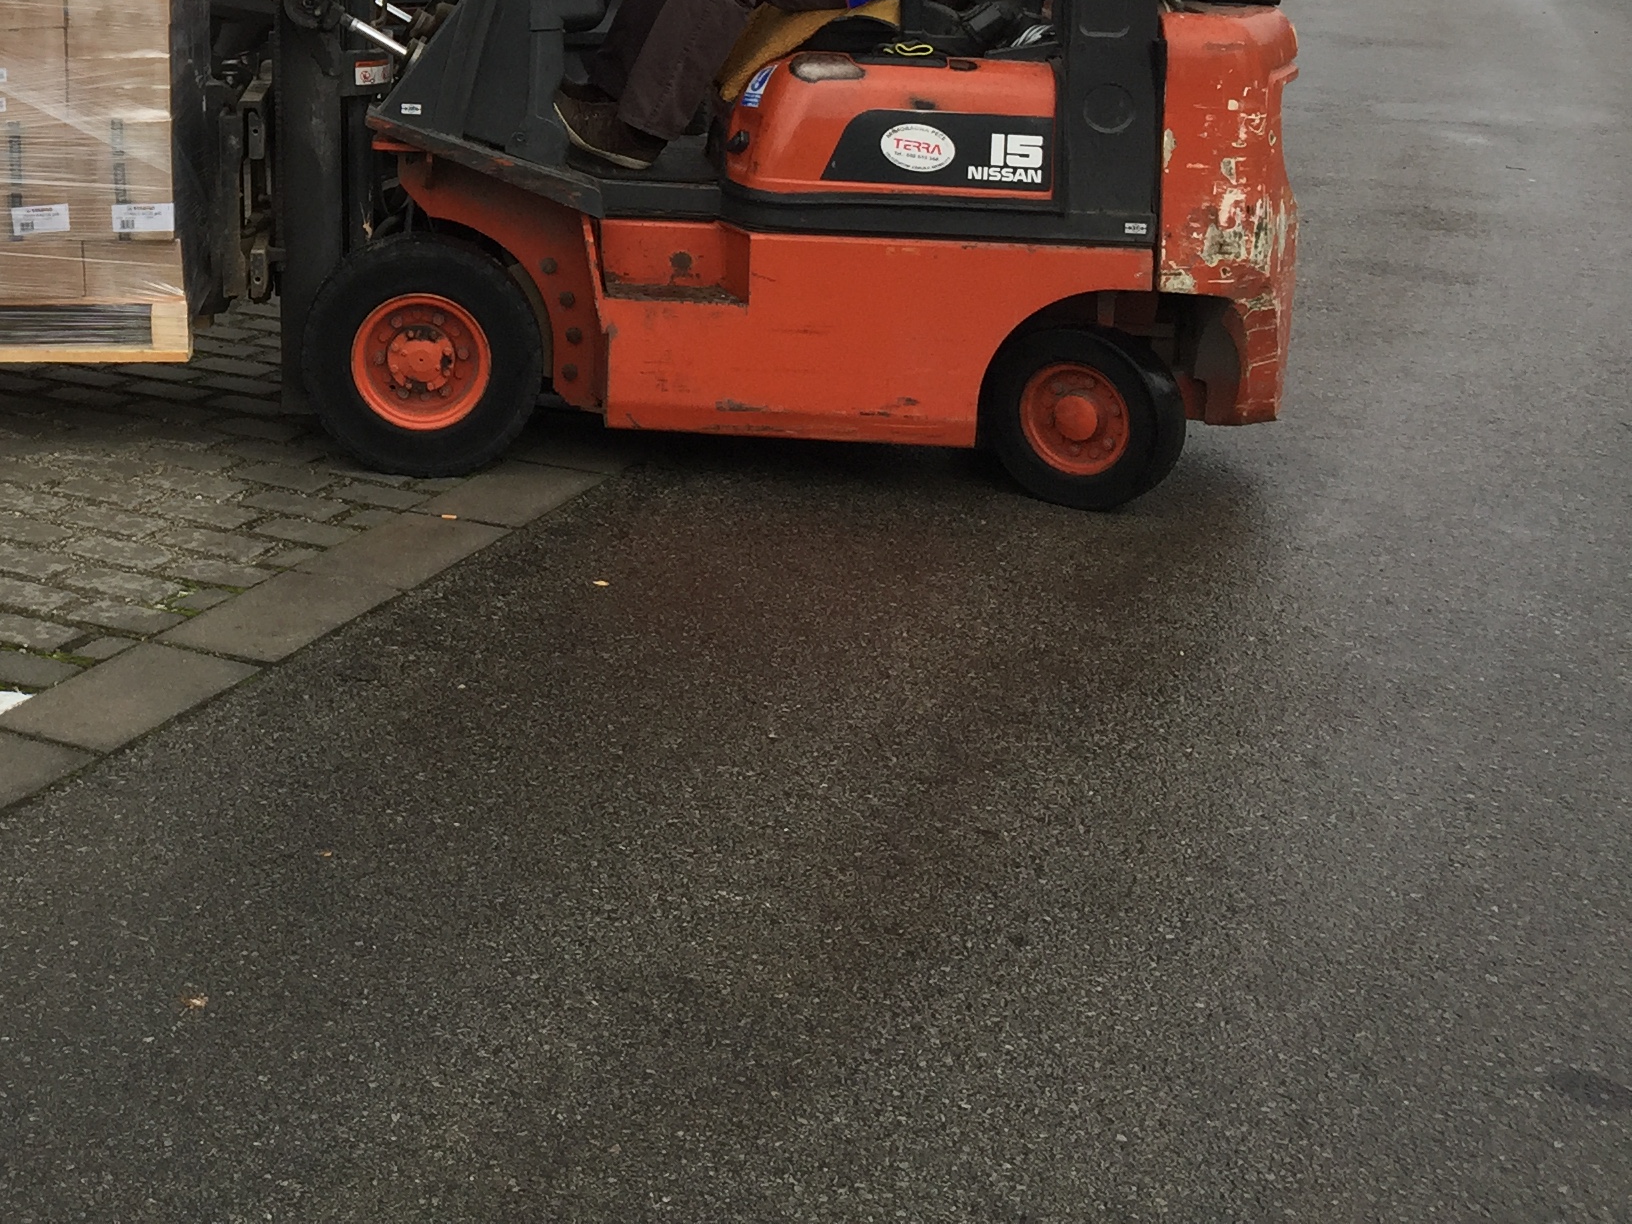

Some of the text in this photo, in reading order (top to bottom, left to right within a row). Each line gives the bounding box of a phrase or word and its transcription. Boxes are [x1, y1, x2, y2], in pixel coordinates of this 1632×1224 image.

[893, 137, 942, 156] TERRA
[990, 133, 1044, 168] 15
[967, 165, 1043, 183] NISSAN
